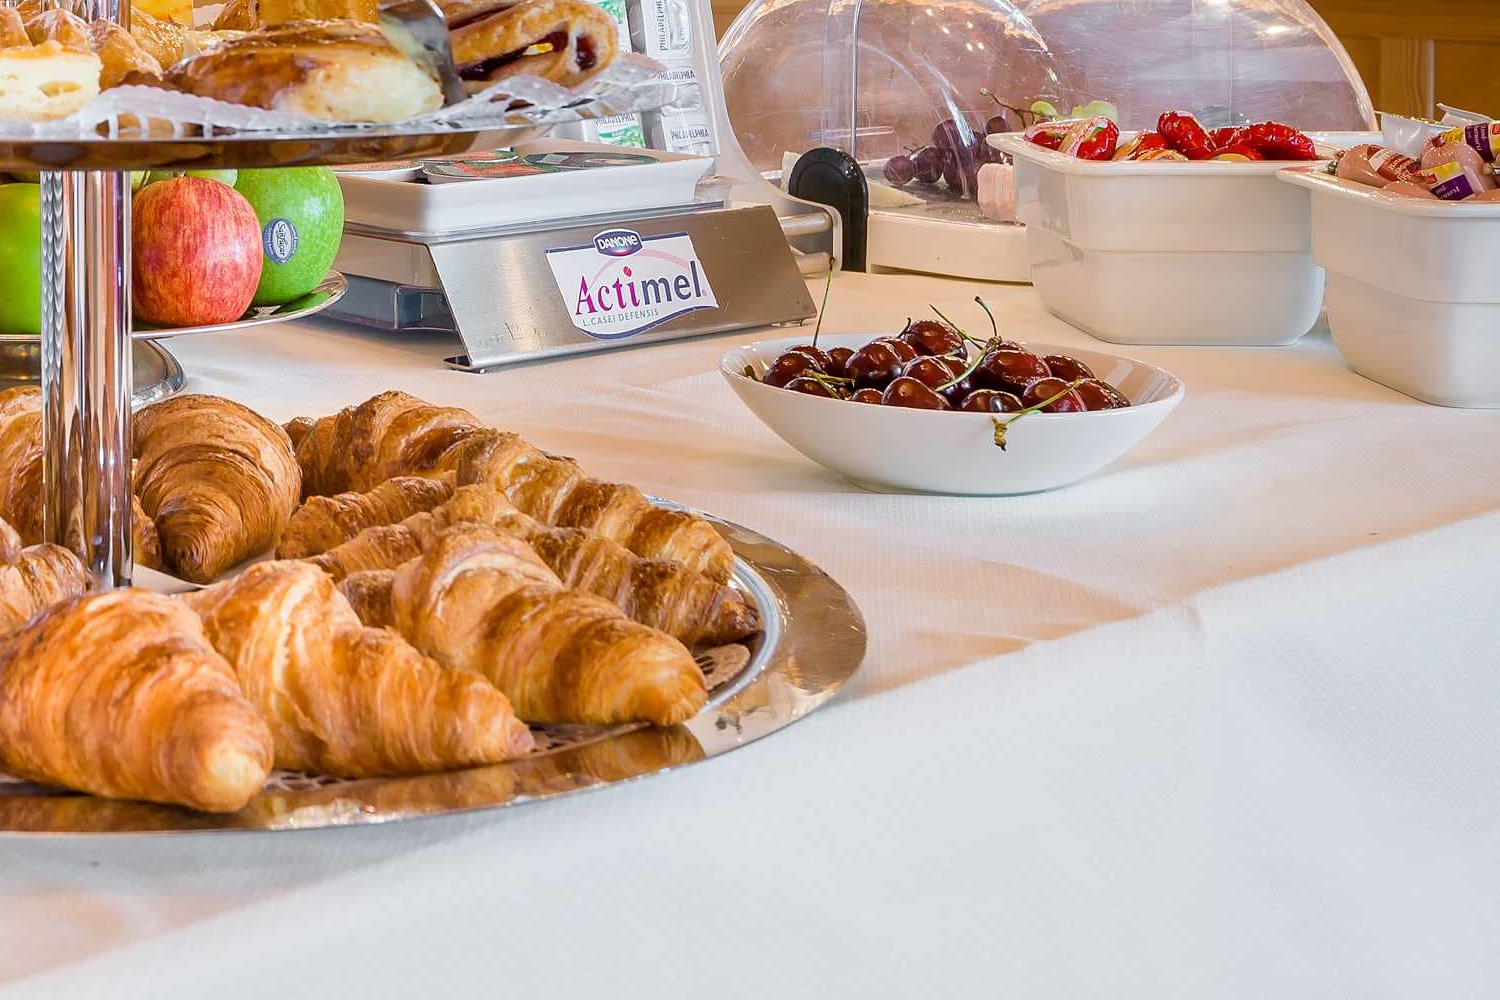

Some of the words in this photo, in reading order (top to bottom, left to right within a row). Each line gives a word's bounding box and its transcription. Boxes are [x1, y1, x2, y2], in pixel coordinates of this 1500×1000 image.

[598, 234, 639, 250] DANONE
[575, 260, 702, 316] Actimel
[619, 307, 660, 322] DEFENSIS
